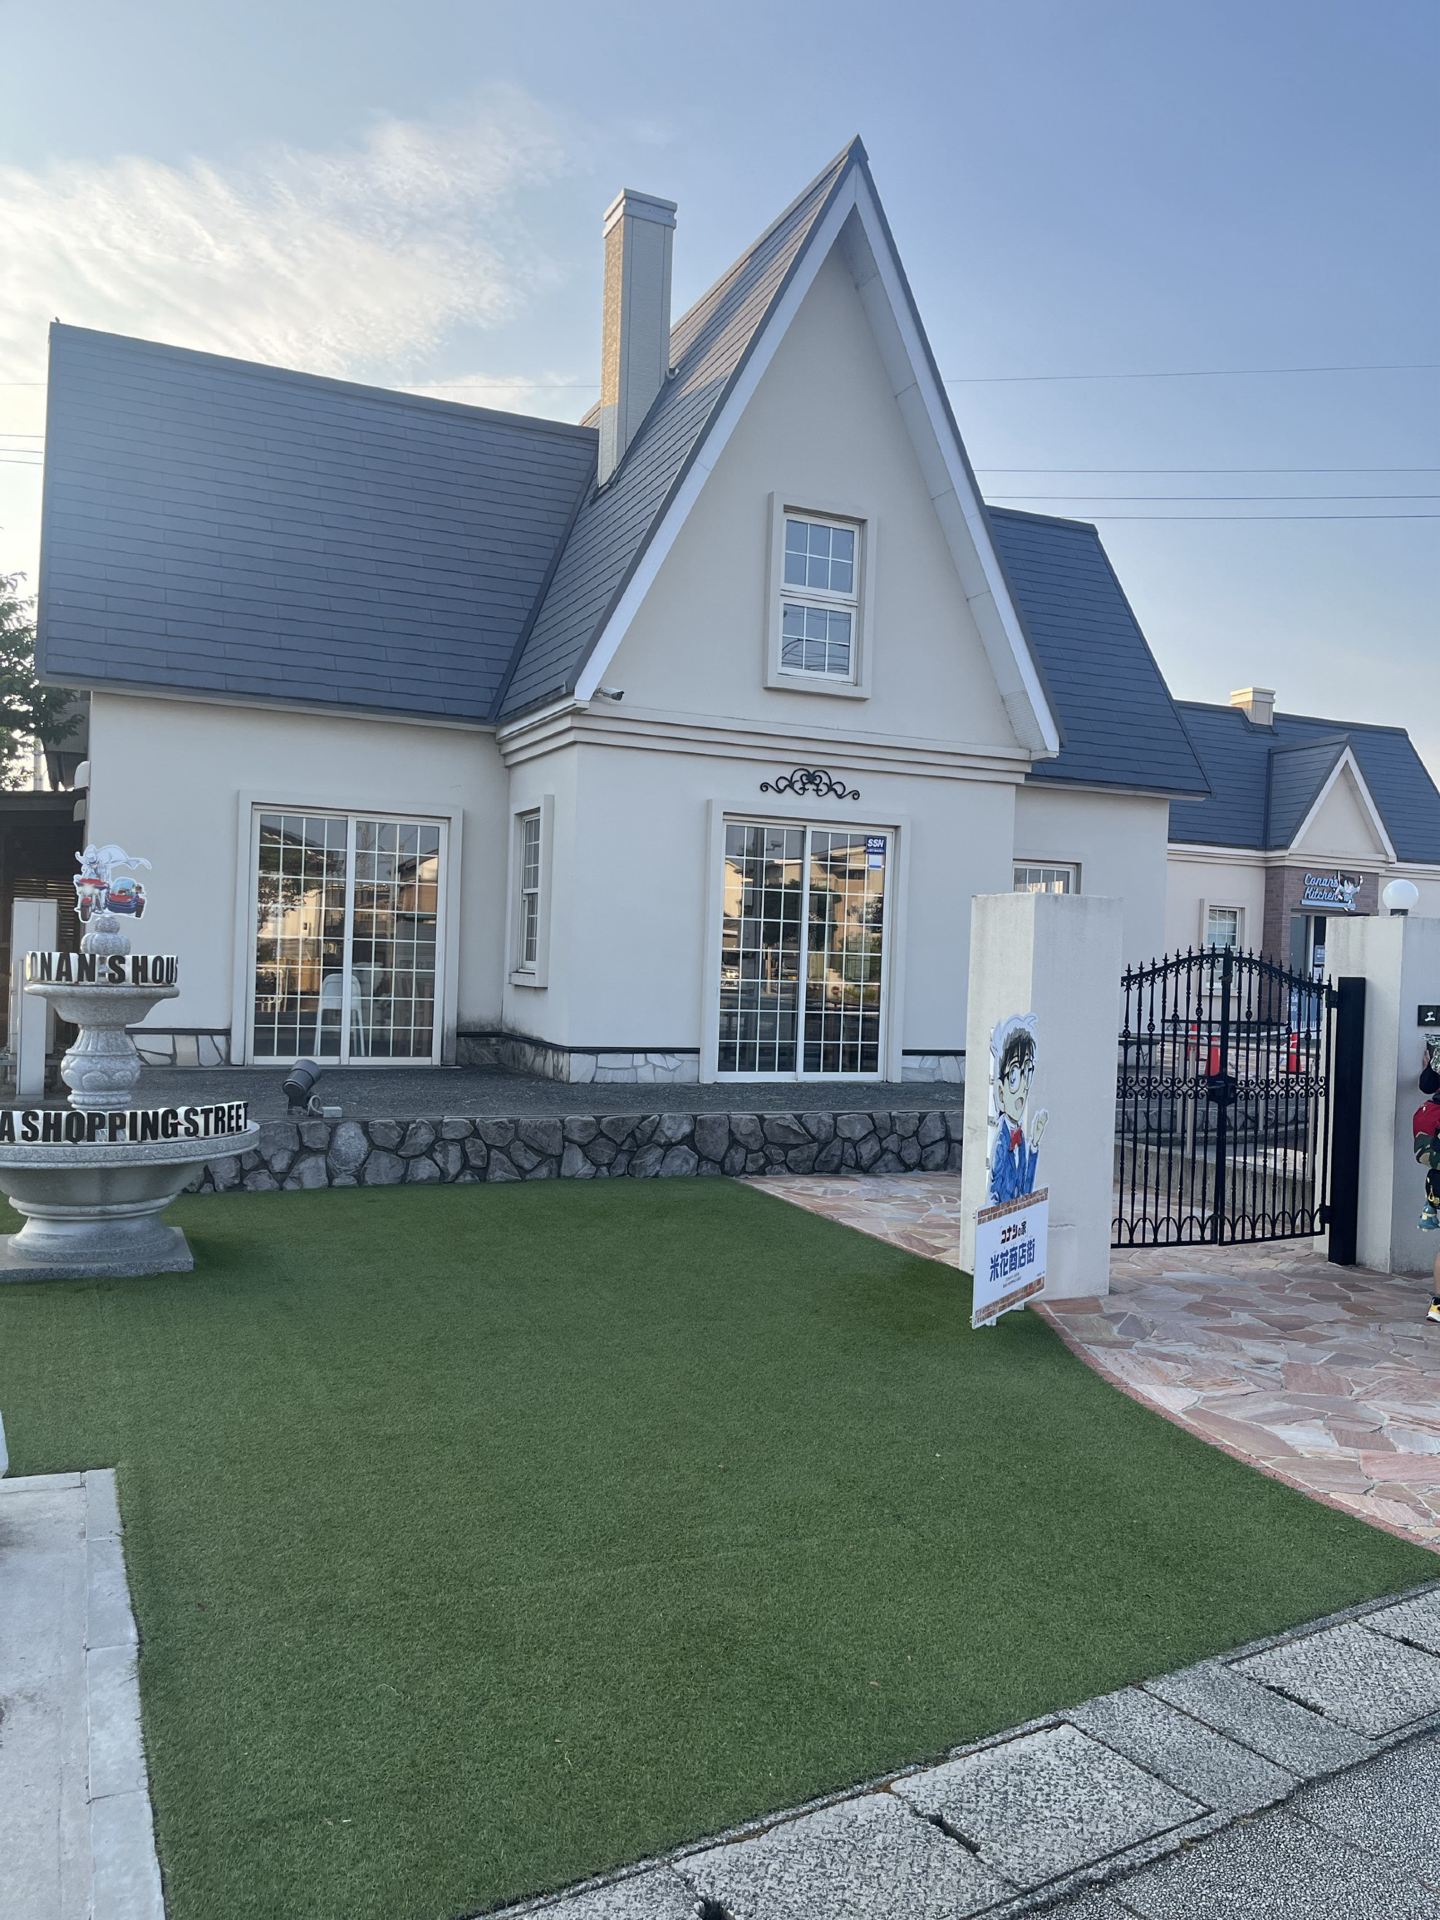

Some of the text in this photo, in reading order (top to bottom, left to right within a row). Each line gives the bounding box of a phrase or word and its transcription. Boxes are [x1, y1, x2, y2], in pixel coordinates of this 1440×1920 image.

[21, 1108, 179, 1143] SHOPPING
[184, 1102, 249, 1138] STREET
[990, 1238, 1036, 1282] 米花商店街
